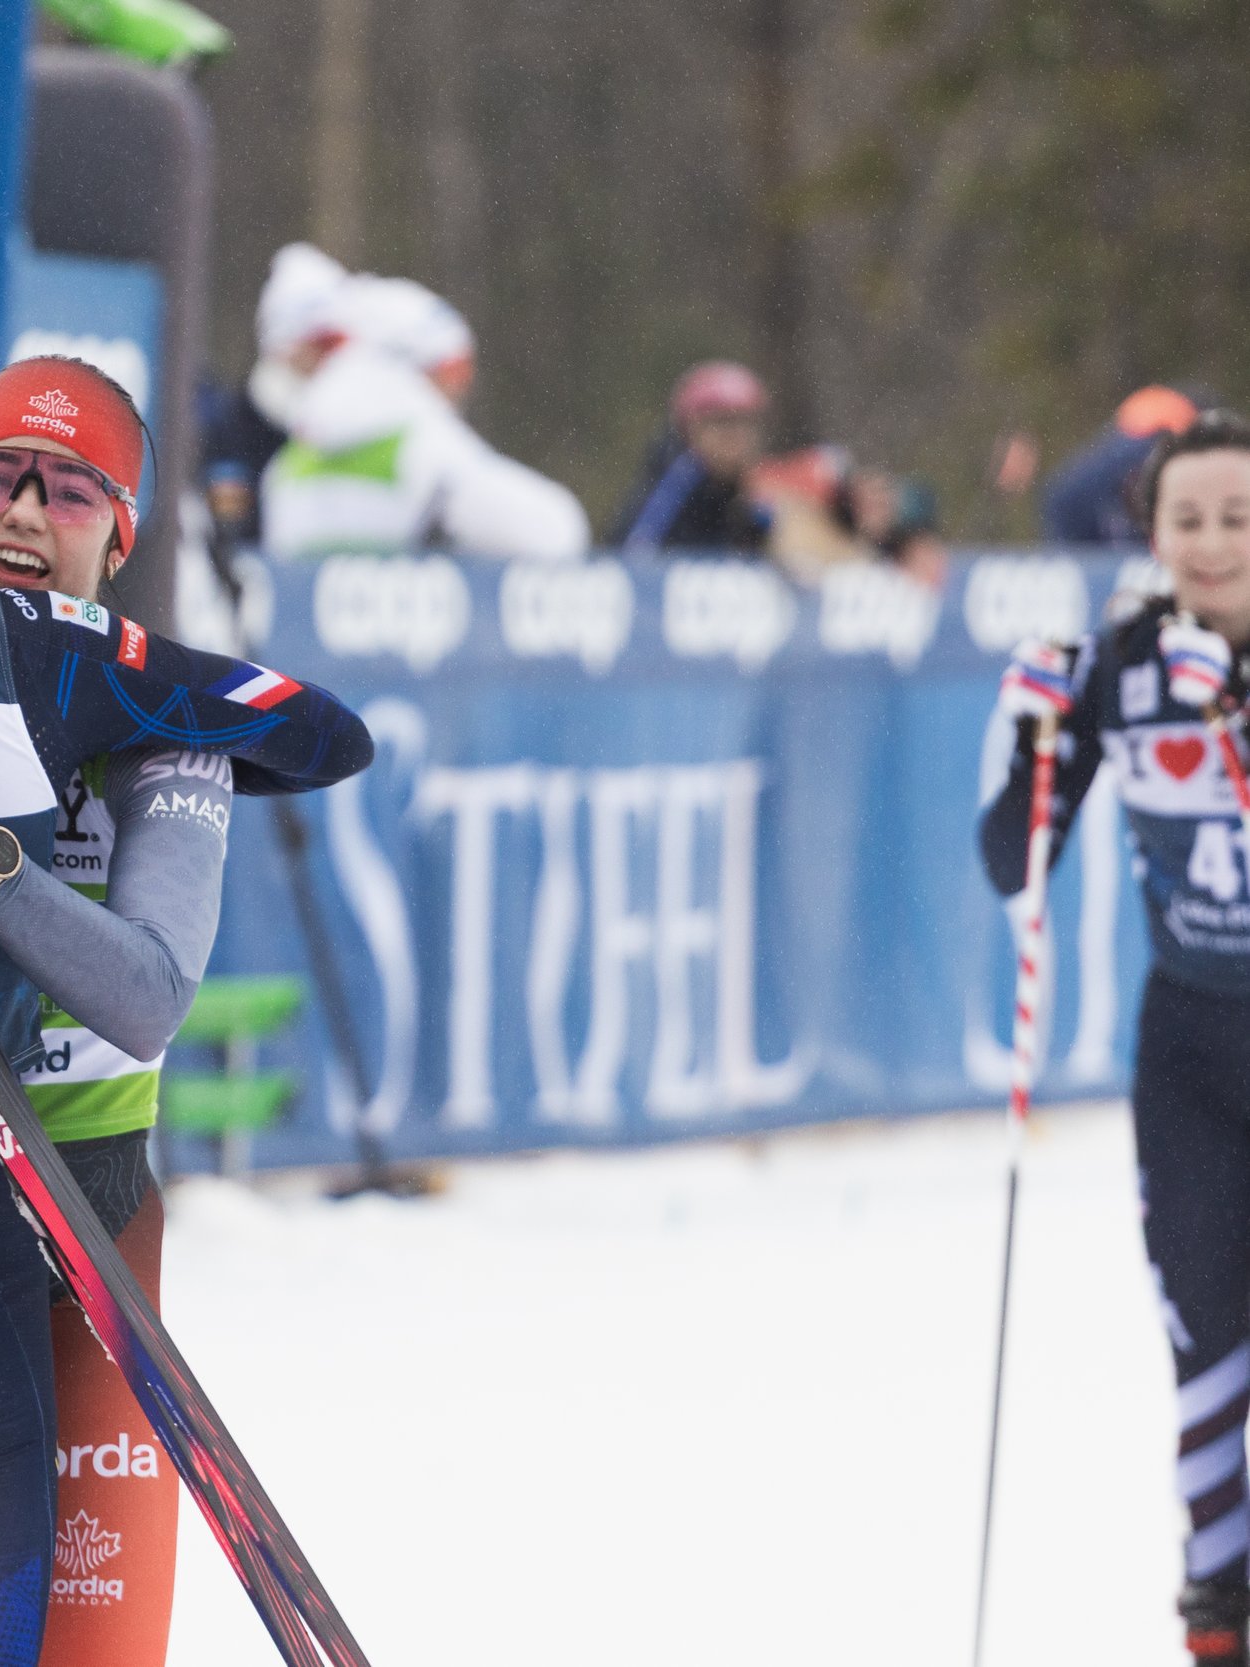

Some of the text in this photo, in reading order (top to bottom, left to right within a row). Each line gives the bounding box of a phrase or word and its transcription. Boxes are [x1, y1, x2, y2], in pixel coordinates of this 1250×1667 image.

[21, 415, 76, 438] nordiq
[27, 423, 67, 437] CANADA
[50, 1575, 123, 1601] ordiq
